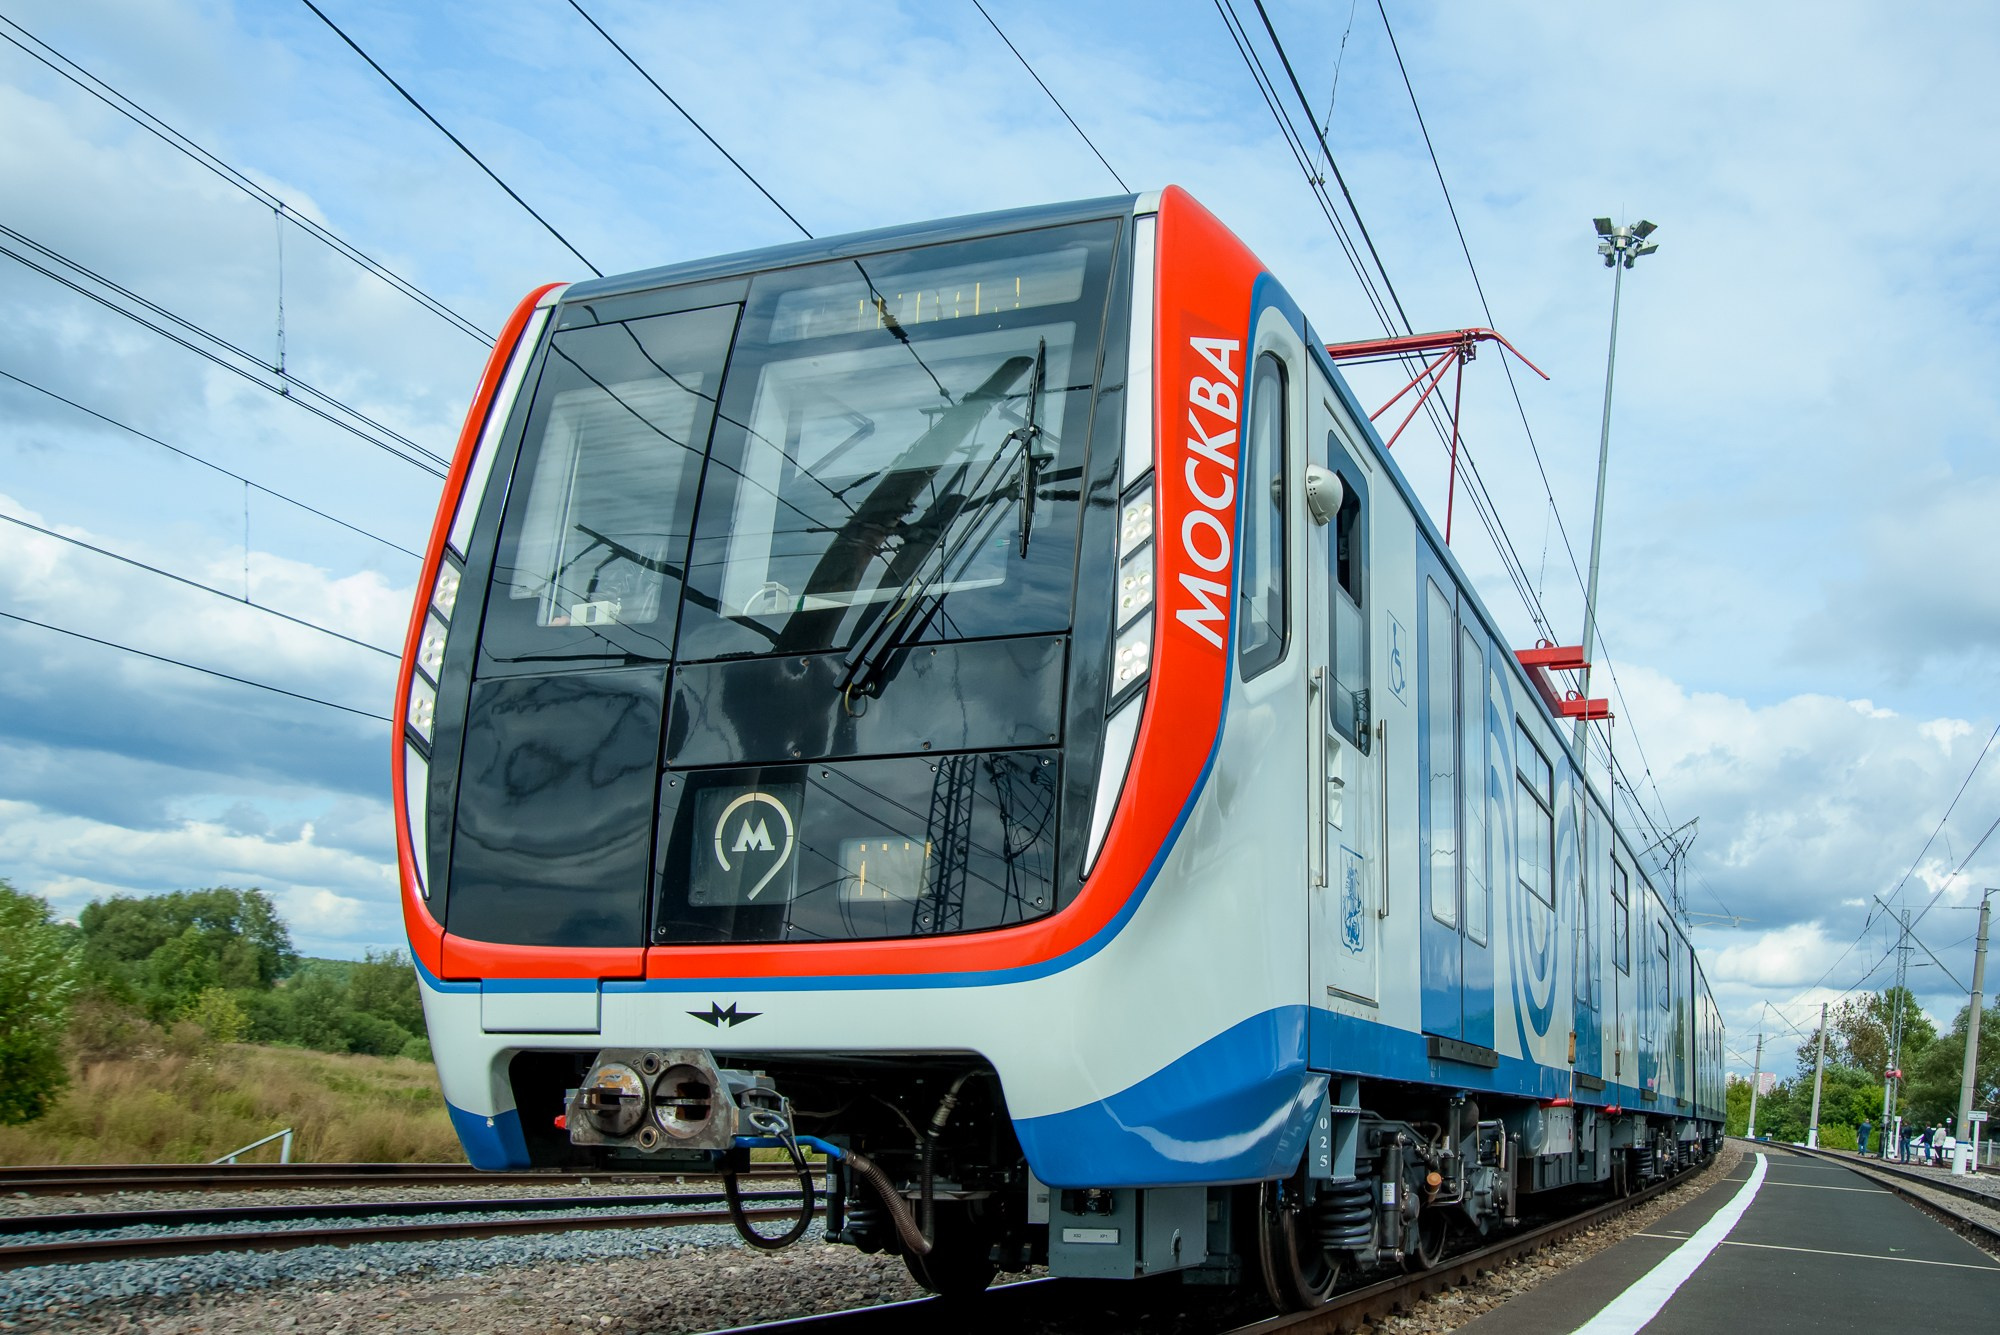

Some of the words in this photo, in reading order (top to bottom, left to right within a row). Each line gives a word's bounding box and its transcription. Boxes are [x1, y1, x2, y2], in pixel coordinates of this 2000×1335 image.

[1176, 336, 1240, 650] МОСКВА
[731, 817, 776, 852] М
[1319, 1117, 1328, 1167] 025
